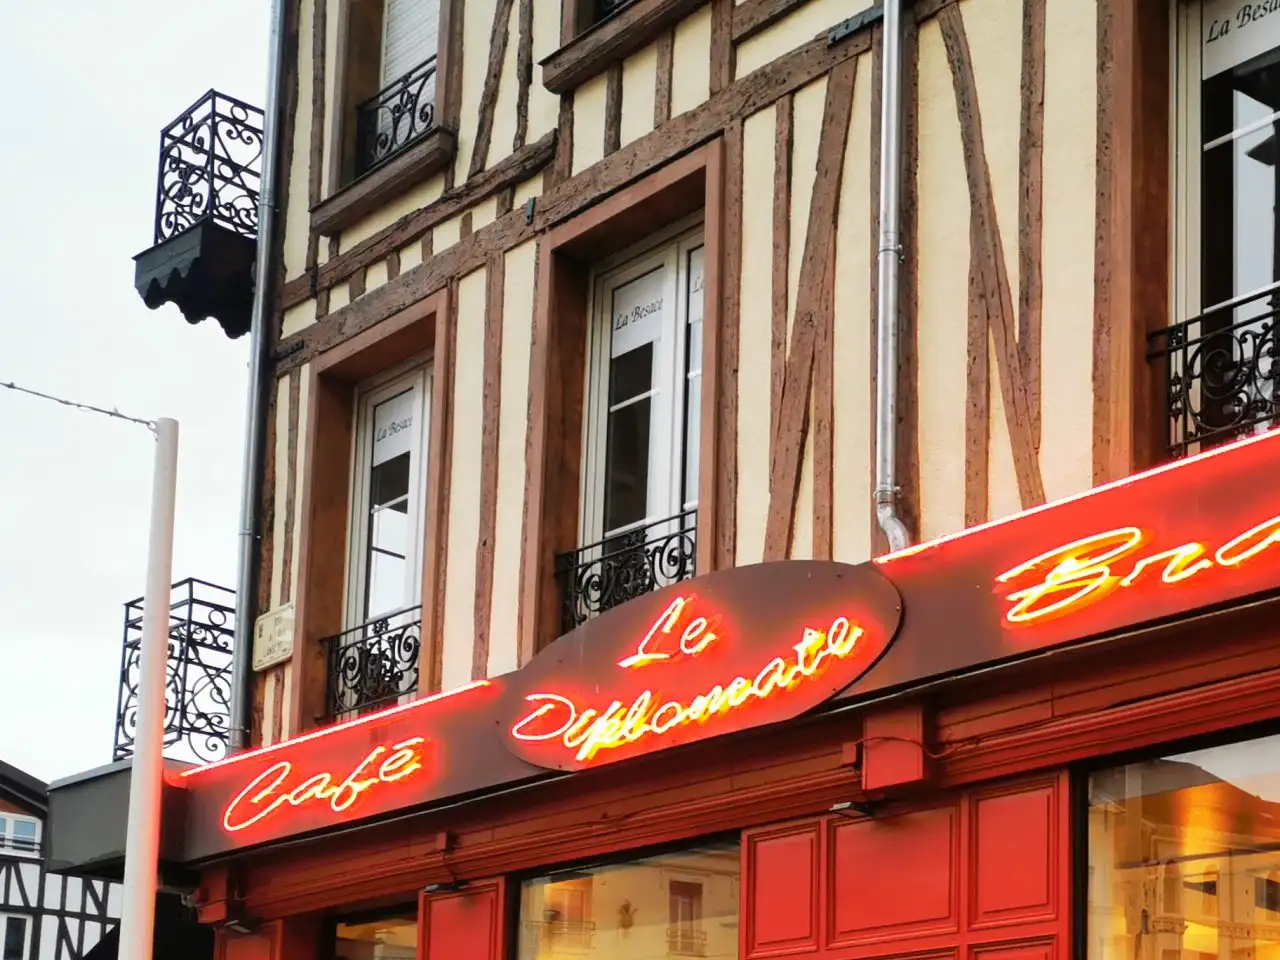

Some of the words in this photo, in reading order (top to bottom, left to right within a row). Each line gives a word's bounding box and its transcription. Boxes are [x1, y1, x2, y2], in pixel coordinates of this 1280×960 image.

[1205, 19, 1231, 44] La
[614, 313, 629, 331] La
[616, 595, 717, 669] Le
[511, 615, 865, 761] Diplomate
[223, 736, 425, 832] Café
